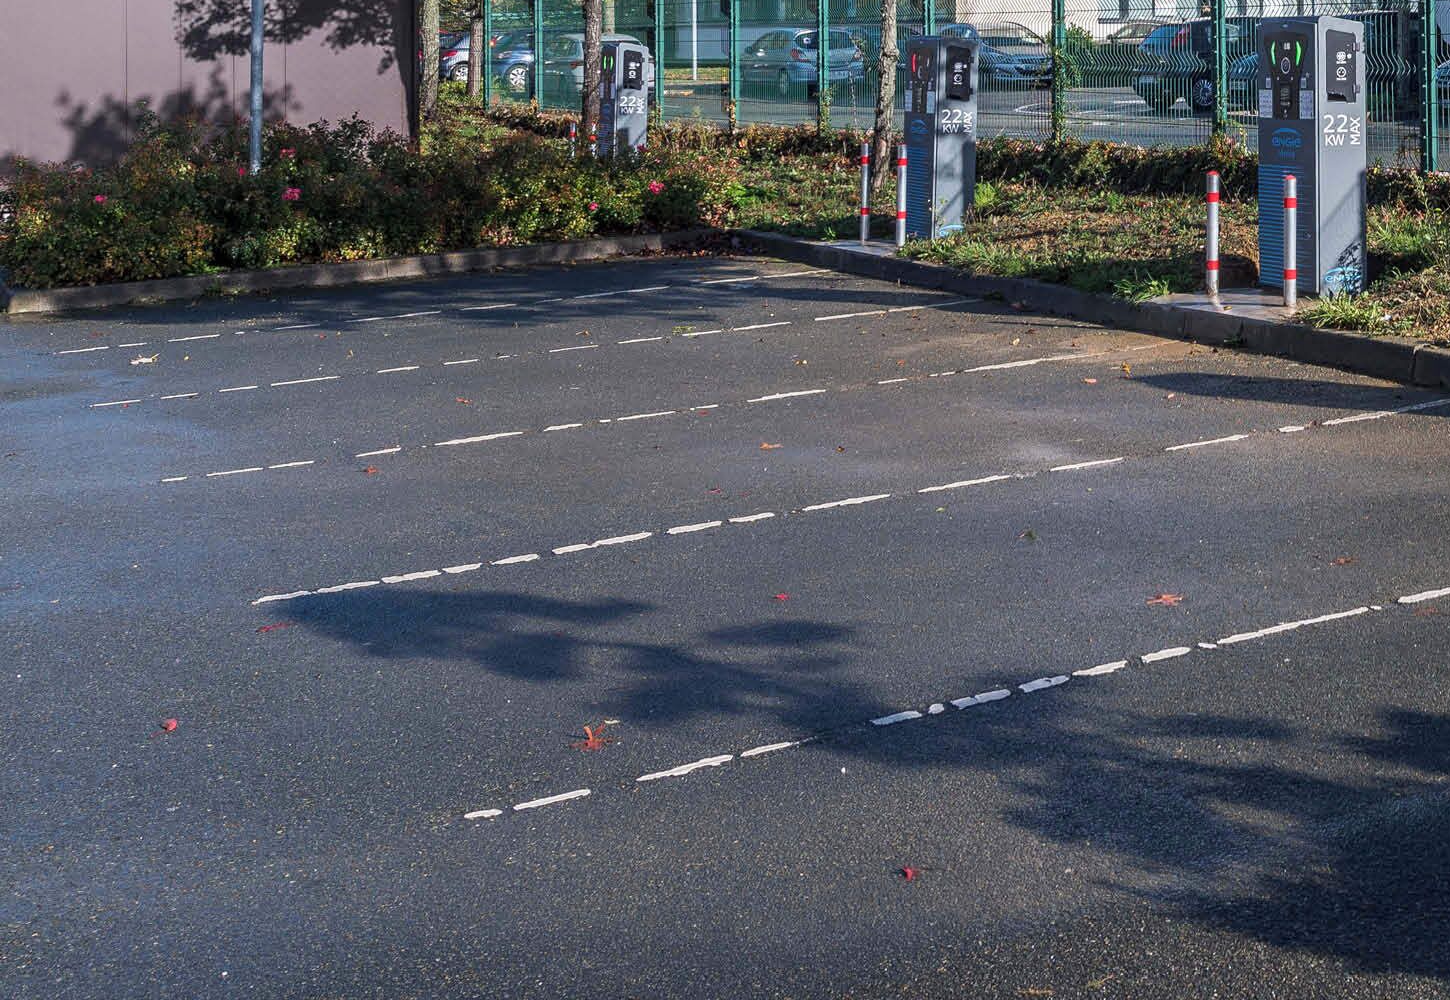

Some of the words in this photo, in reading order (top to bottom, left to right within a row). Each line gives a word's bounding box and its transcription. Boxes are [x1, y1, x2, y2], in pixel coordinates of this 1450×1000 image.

[620, 96, 637, 107] 22
[941, 109, 962, 124] 22
[963, 111, 973, 133] MAX
[1323, 114, 1348, 133] 22
[943, 124, 959, 133] KW
[1350, 117, 1361, 145] MAX
[1325, 134, 1345, 146] KW
